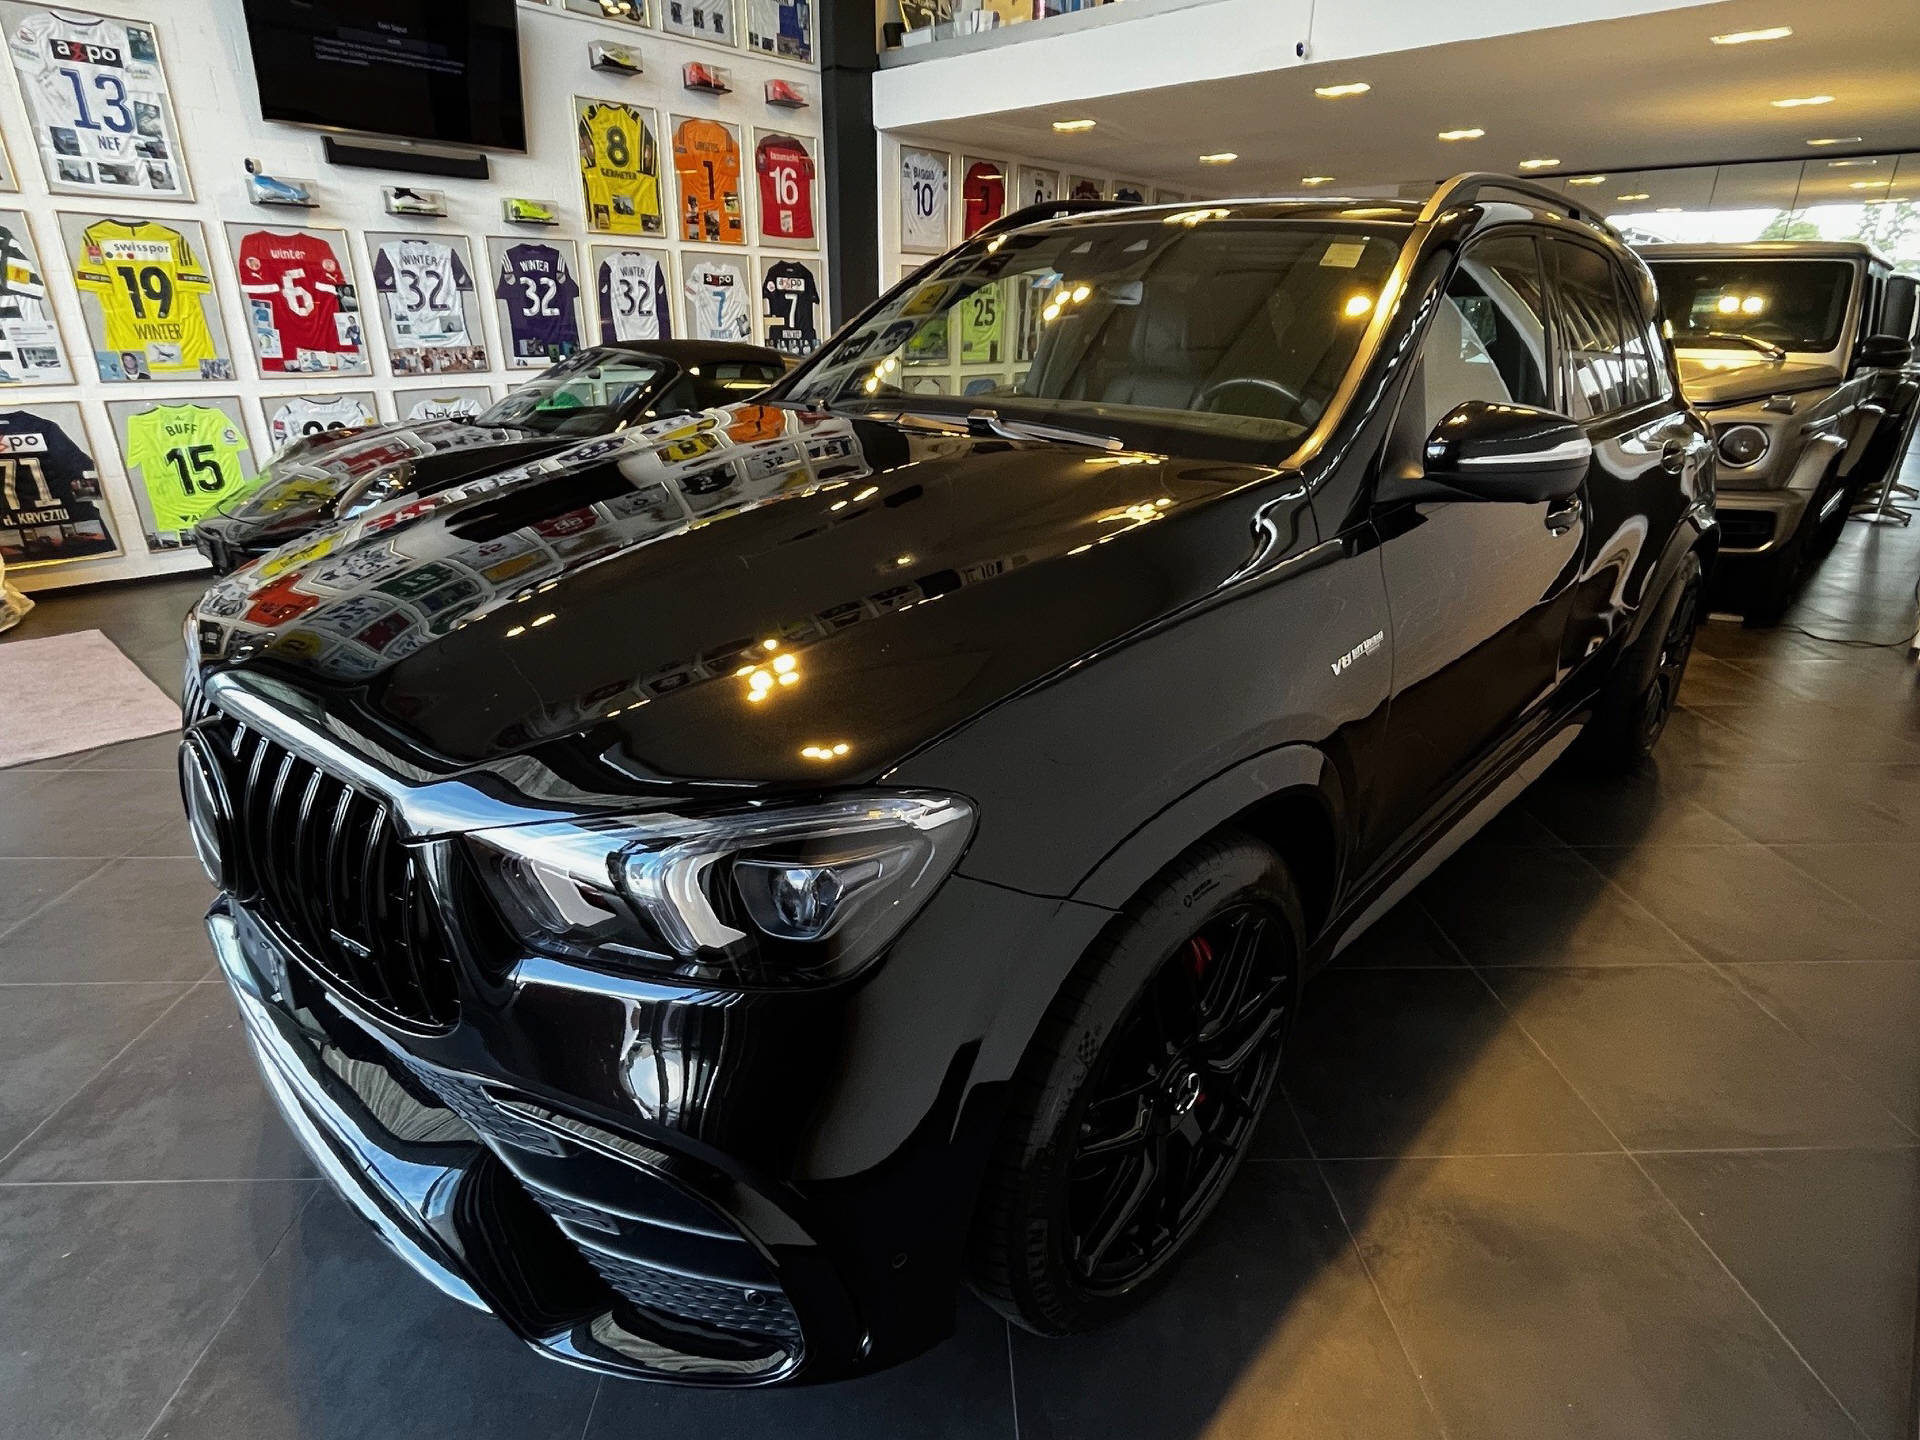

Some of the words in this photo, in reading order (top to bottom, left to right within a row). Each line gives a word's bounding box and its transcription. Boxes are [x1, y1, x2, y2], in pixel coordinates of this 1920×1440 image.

[60, 67, 135, 133] 13
[97, 135, 121, 151] NEF
[607, 125, 630, 168] 8
[703, 161, 715, 200] 1
[769, 166, 799, 205] 16
[913, 181, 933, 216] 10
[113, 242, 169, 254] swisspor
[270, 249, 306, 260] winter
[401, 254, 440, 267] WINTER
[519, 260, 549, 273] WINTER
[620, 266, 646, 277] WINTER
[117, 266, 173, 319] 19
[280, 268, 315, 317] 6
[401, 270, 450, 312] 32
[520, 277, 560, 317] 32
[619, 279, 653, 316] 32
[713, 291, 726, 327] 7
[784, 294, 798, 328] 7
[974, 298, 995, 327] 25
[134, 324, 183, 340] WINTER
[165, 423, 198, 437] BUFF
[165, 445, 226, 496] 15
[18, 508, 70, 525] KRYEZIU
